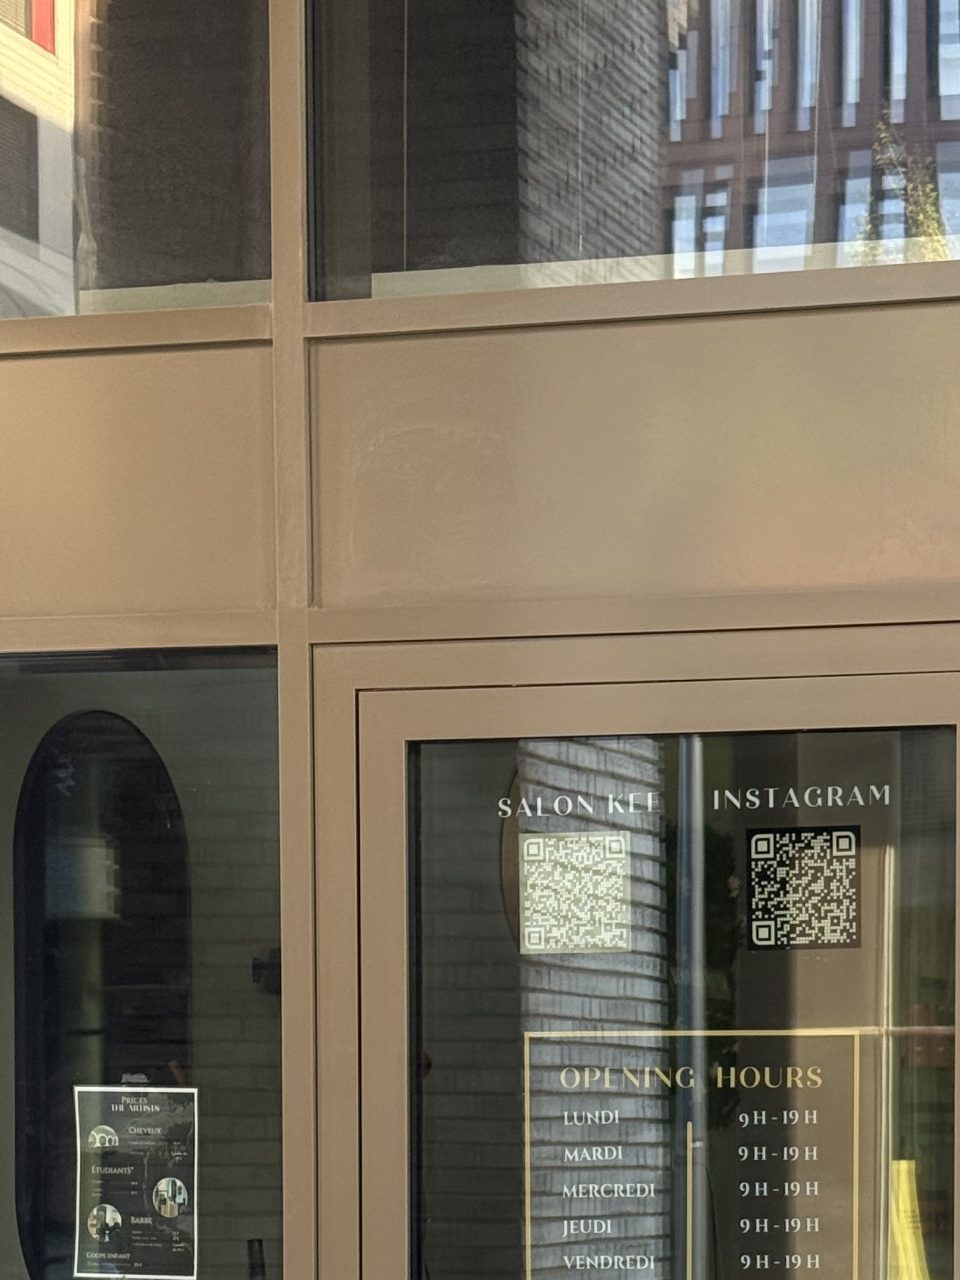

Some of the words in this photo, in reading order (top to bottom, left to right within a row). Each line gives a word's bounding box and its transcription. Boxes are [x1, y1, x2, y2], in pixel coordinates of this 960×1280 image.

[498, 795, 594, 818] SALON
[608, 792, 661, 814] KEE
[714, 785, 891, 810] INSTAGRAM
[560, 1067, 695, 1089] OPENING
[716, 1066, 822, 1088] HOURS
[563, 1110, 619, 1125] LUNDI
[564, 1146, 623, 1162] MARDI
[563, 1183, 655, 1198] MERCREDI
[563, 1220, 612, 1237] JEUDI
[563, 1255, 655, 1269] VENDREDI
